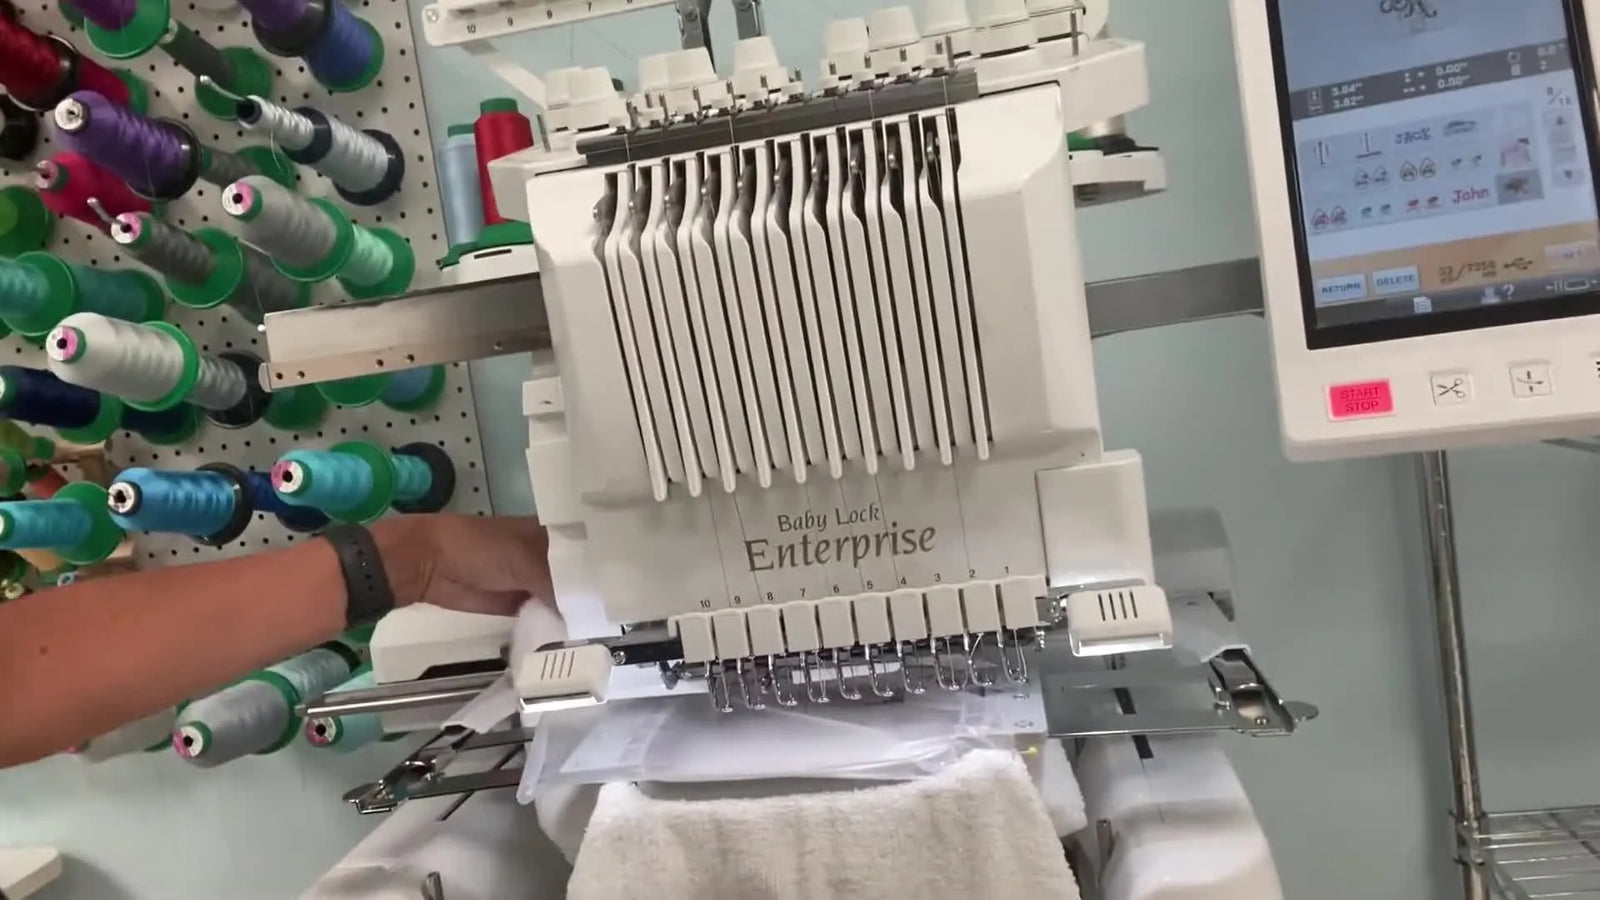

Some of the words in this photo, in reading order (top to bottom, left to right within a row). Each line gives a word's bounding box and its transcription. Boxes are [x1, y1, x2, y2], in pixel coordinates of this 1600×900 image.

[466, 24, 476, 34] 10
[507, 17, 514, 26] 9
[586, 2, 592, 12] 7
[1452, 187, 1490, 204] John
[1321, 282, 1361, 294] RETURN
[1376, 274, 1415, 287] DELETE
[1339, 386, 1379, 400] START
[1345, 400, 1379, 412] STOP
[777, 508, 828, 533] Baby
[834, 501, 882, 526] Lock
[743, 520, 938, 573] Enterprise
[699, 598, 711, 609] 10
[733, 595, 741, 605] 9
[766, 591, 774, 601] 8
[799, 588, 806, 597] 7
[833, 584, 840, 594] 6
[866, 580, 874, 590] 5
[899, 576, 907, 586] 4
[934, 572, 941, 582] 3
[968, 568, 976, 578] 2
[1003, 565, 1009, 575] 1
